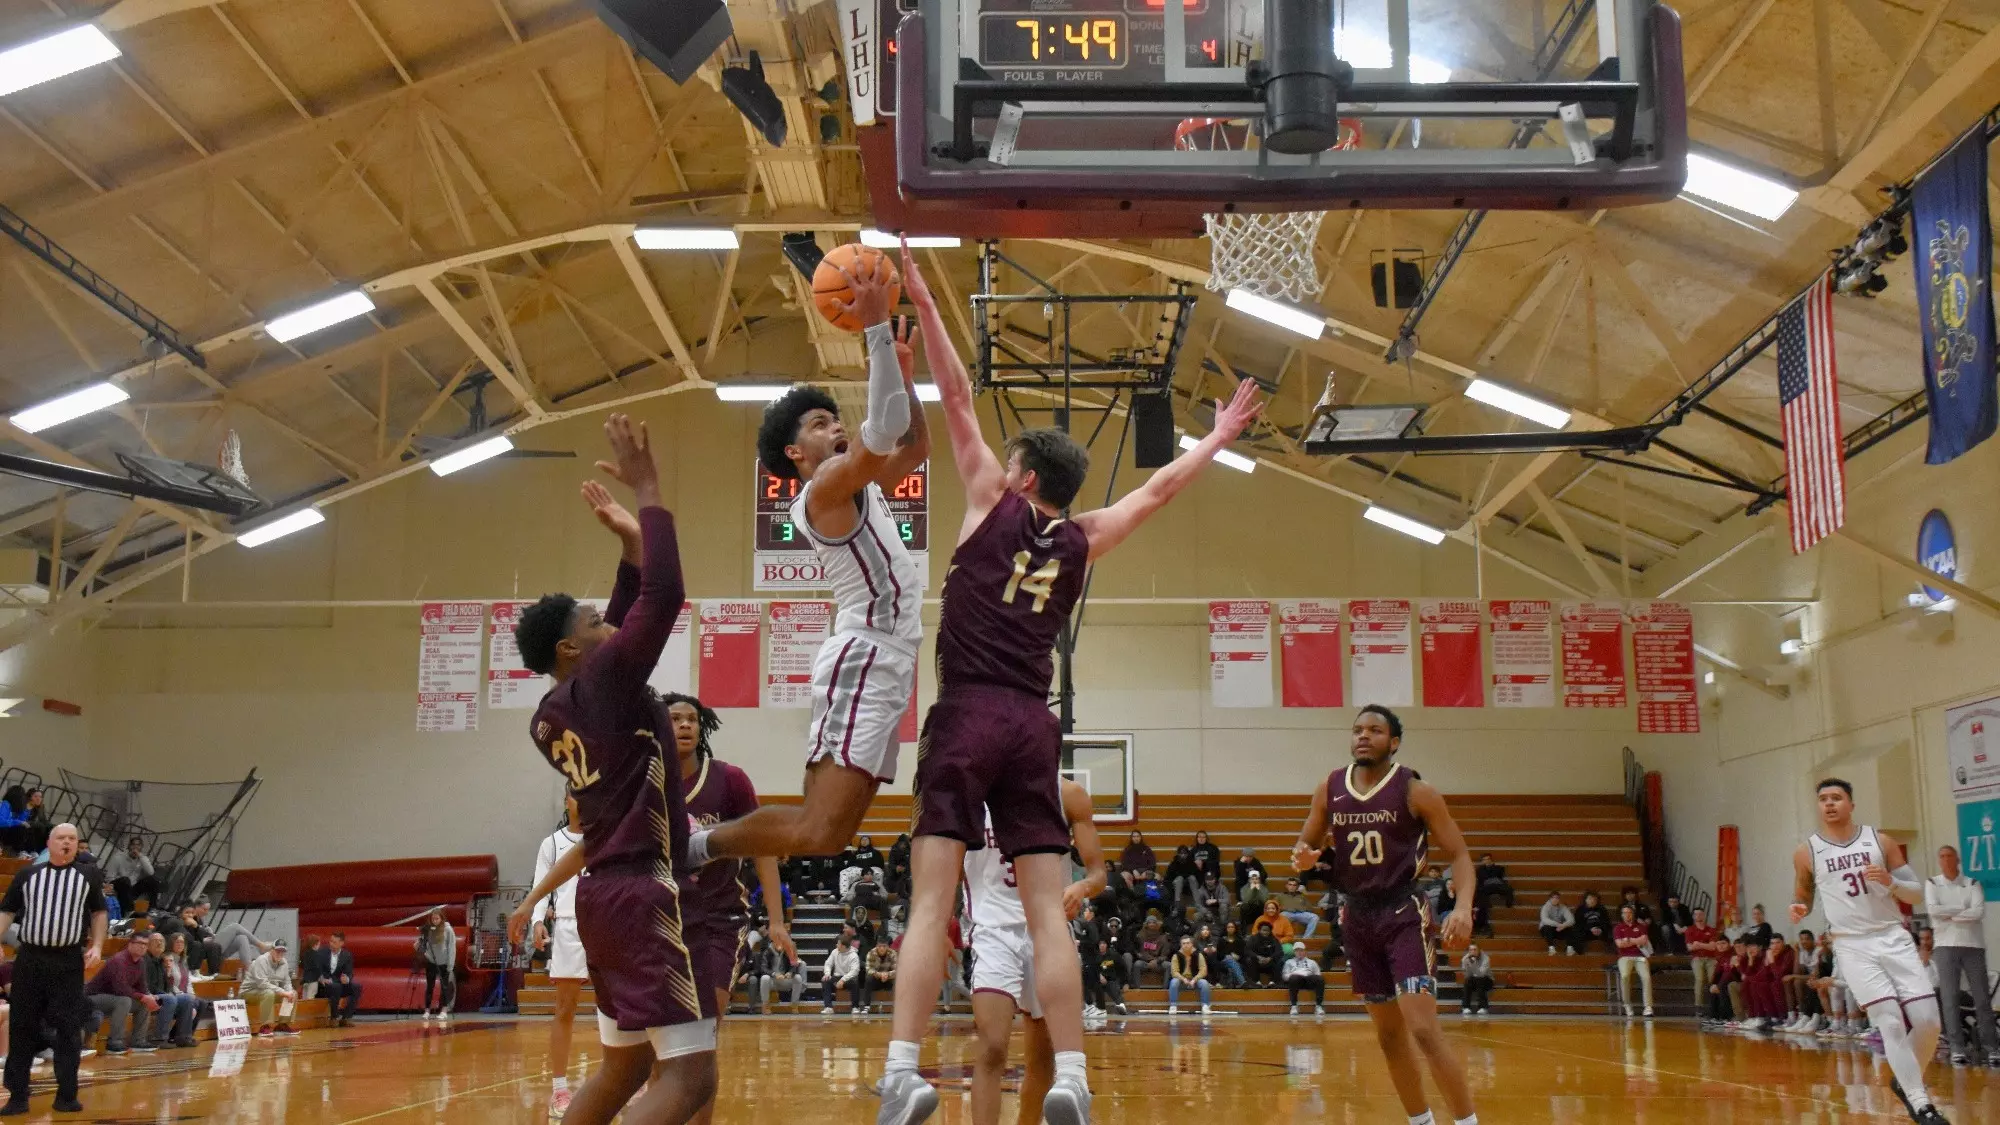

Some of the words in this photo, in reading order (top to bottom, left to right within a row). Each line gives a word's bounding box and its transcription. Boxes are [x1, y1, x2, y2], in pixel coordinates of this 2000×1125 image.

[1130, 21, 1165, 31] BONU
[1016, 20, 1116, 60] 7:49
[1235, 5, 1254, 66] LH
[850, 8, 871, 97] LHU
[1201, 39, 1217, 60] 4
[1004, 72, 1045, 82] FOULS
[1056, 72, 1104, 82] PLAYER
[767, 477, 797, 498] 21
[894, 476, 923, 498] 20
[774, 501, 791, 510] BON
[889, 501, 910, 509] ONUS
[782, 523, 794, 541] 3
[901, 523, 914, 541] 5
[1002, 550, 1061, 614] 14
[442, 604, 459, 616] FIELD
[459, 604, 484, 616] HOCKEY
[720, 603, 761, 615] FOOTBALL
[1439, 602, 1480, 613] BASEBALL
[1509, 602, 1551, 614] SOFTBALL
[704, 625, 720, 633] PSAC
[771, 624, 796, 632] NATIONAL
[1214, 652, 1230, 661] PSAC
[494, 671, 510, 679] PSAC
[773, 674, 788, 683] PSAC
[420, 694, 458, 702] CONFERENCE
[551, 728, 602, 791] 32
[1332, 810, 1398, 826] KUTZTOWN
[1346, 830, 1384, 866] 20
[1966, 833, 2000, 872] ZT
[1825, 851, 1871, 873] HAVEN
[1842, 870, 1869, 898] 31
